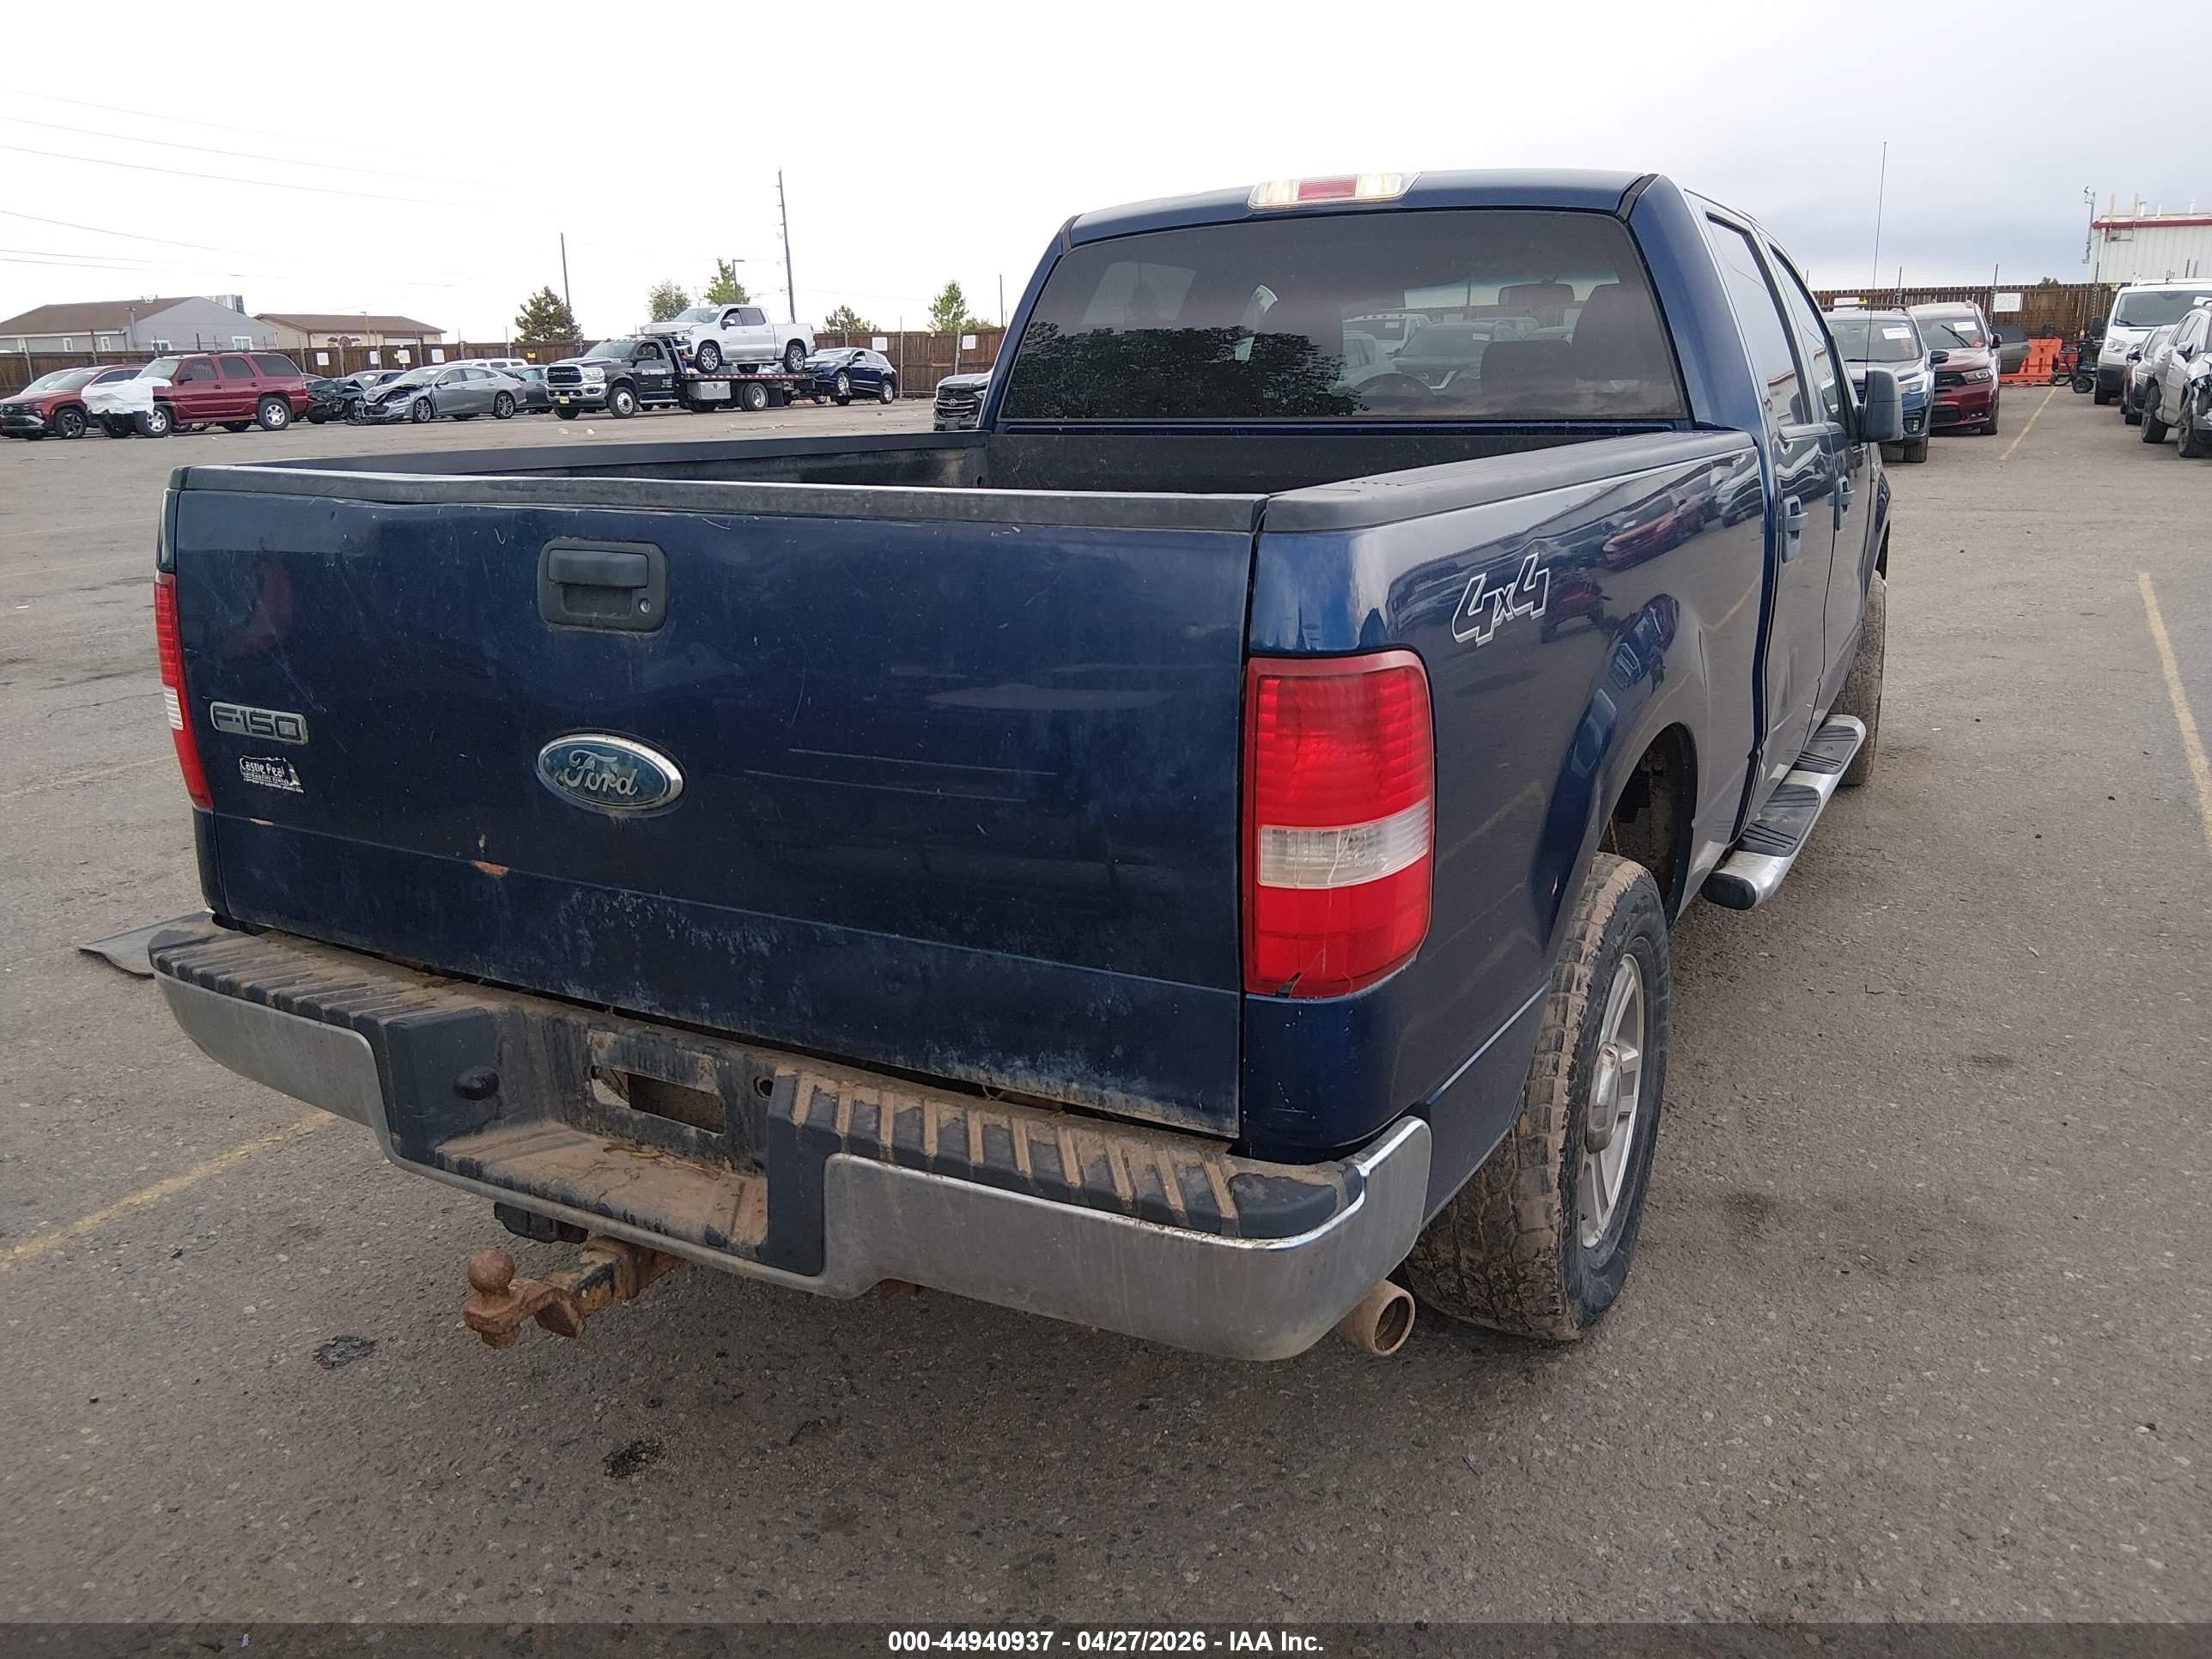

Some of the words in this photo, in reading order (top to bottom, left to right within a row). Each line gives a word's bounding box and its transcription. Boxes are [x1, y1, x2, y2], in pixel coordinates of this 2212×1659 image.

[1452, 552, 1550, 647] 4x4
[212, 705, 302, 741] F-150
[240, 758, 266, 775] Castle
[564, 750, 638, 796] Ford
